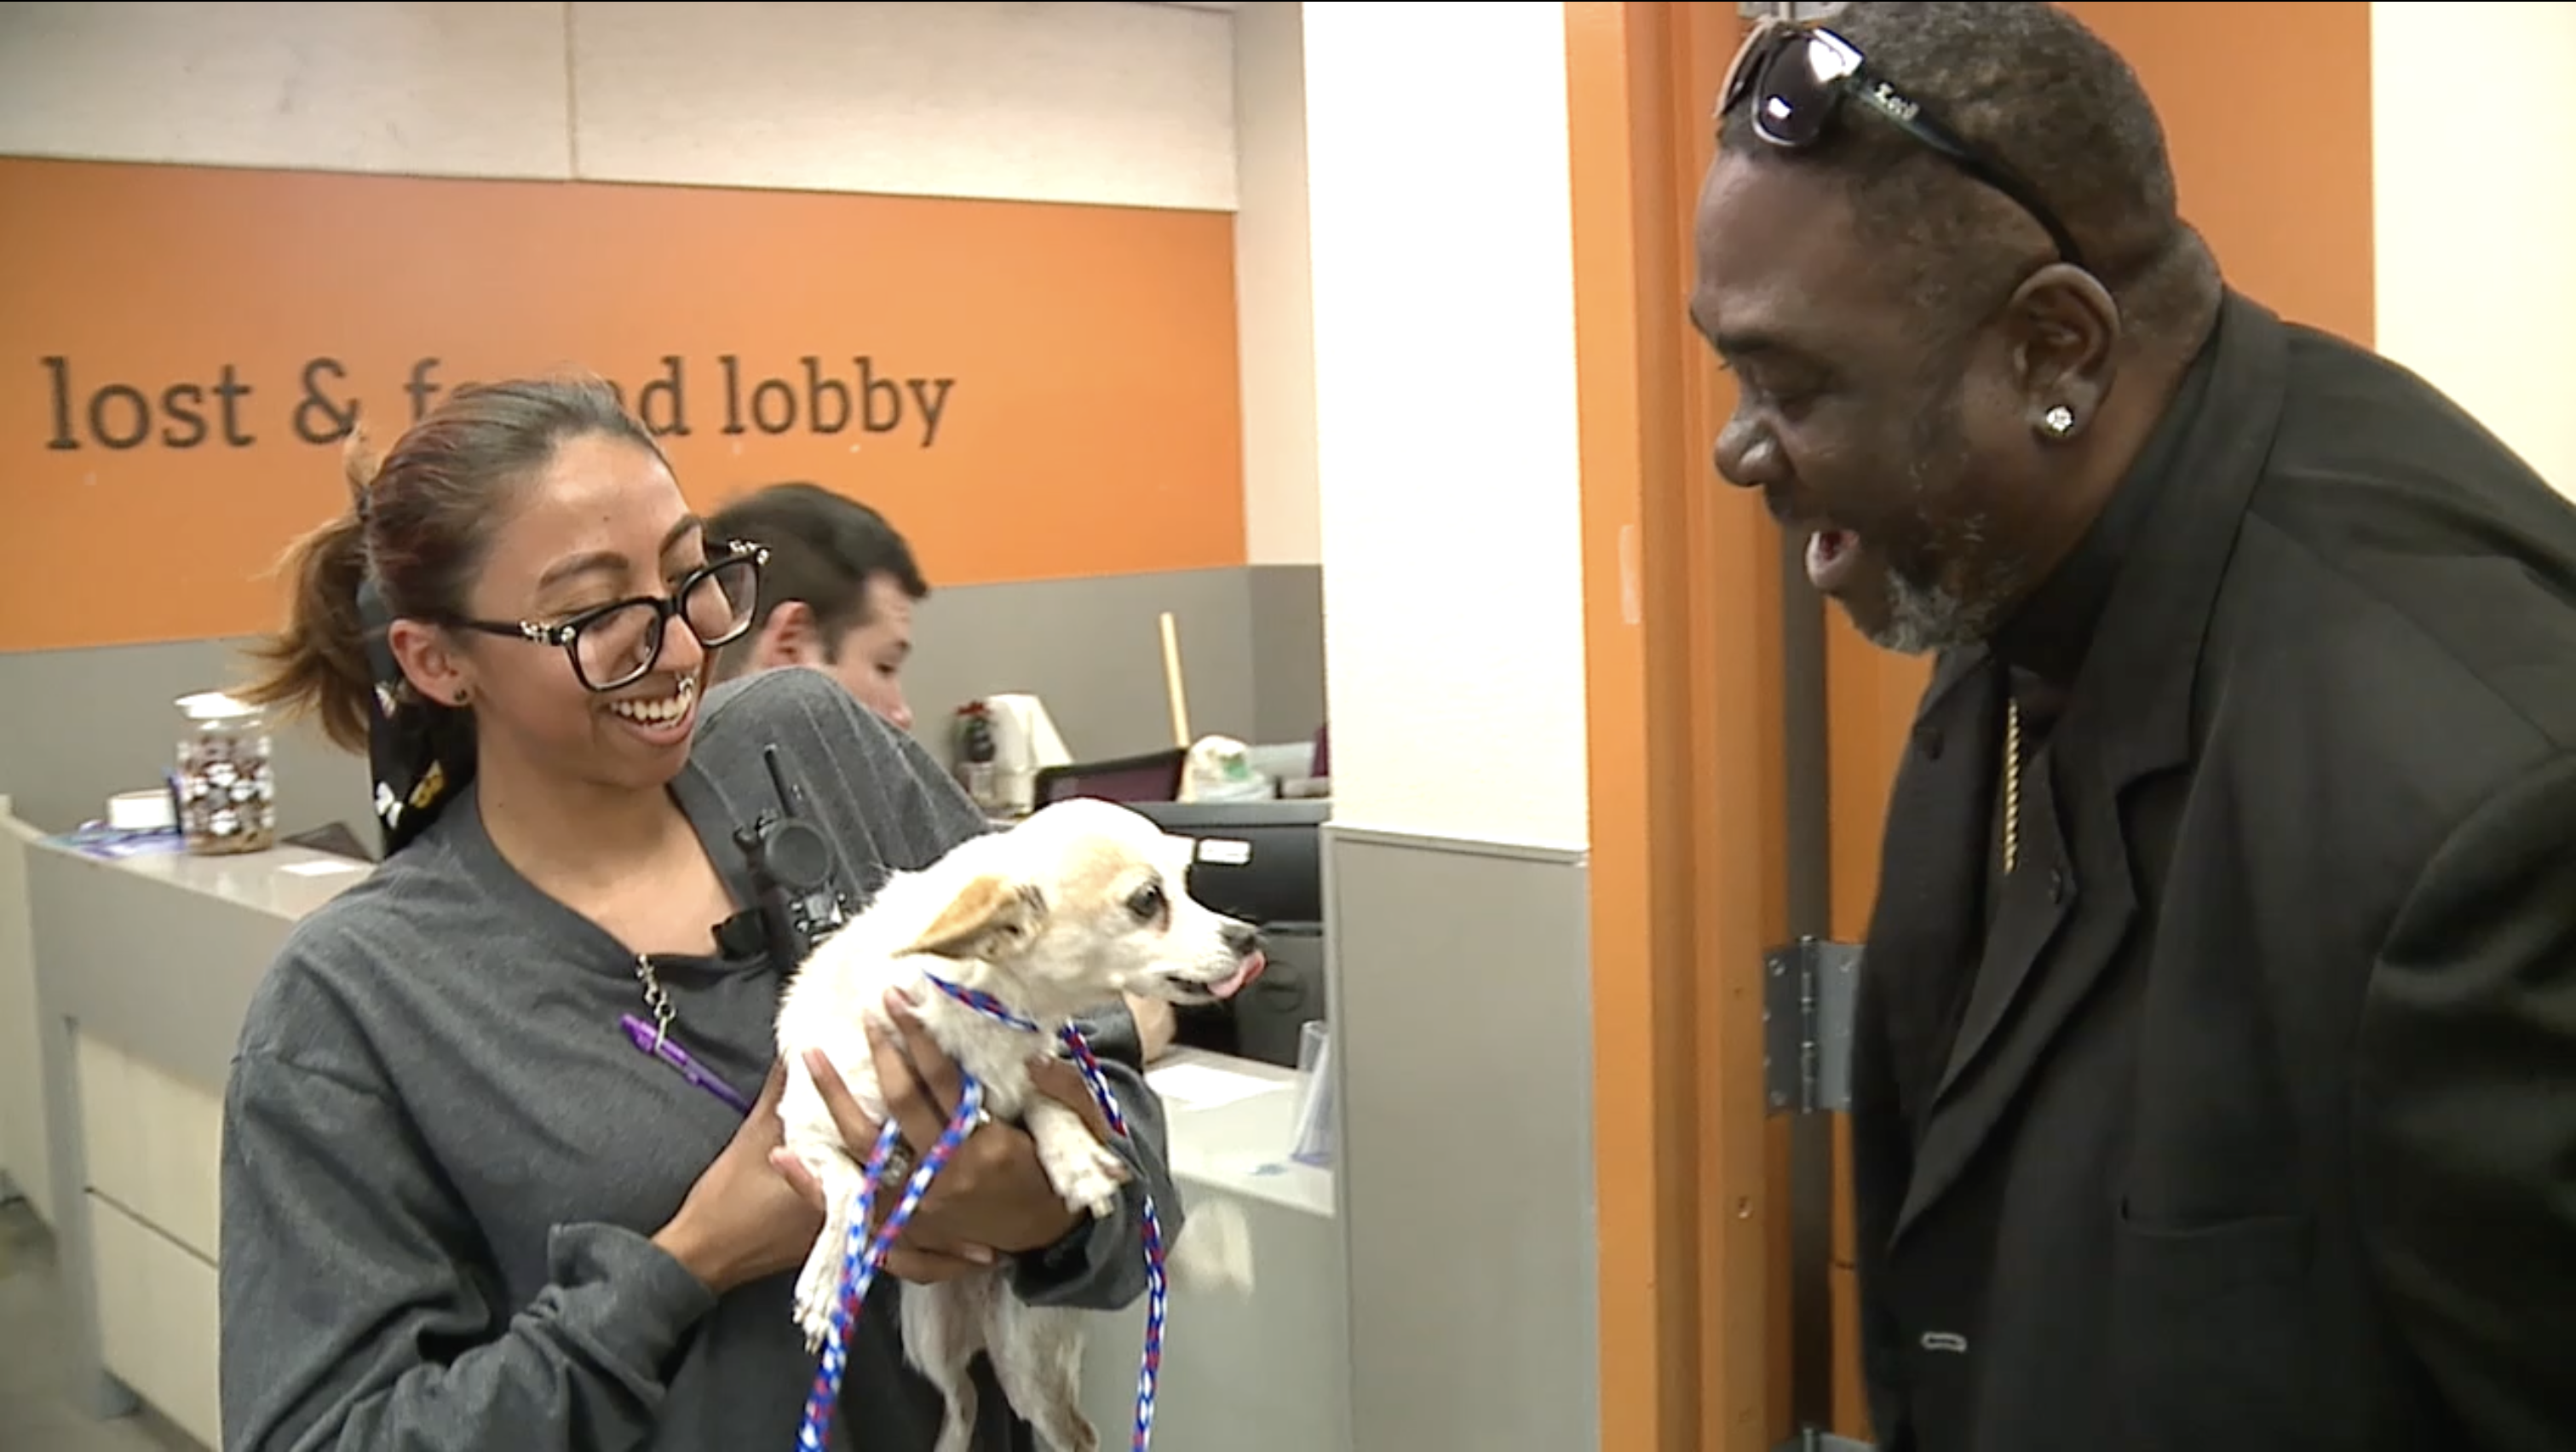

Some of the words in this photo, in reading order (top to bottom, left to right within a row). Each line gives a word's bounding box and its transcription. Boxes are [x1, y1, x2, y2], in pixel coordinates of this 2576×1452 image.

[40, 355, 256, 450] lost
[292, 356, 360, 445] &
[717, 354, 956, 448] lobby
